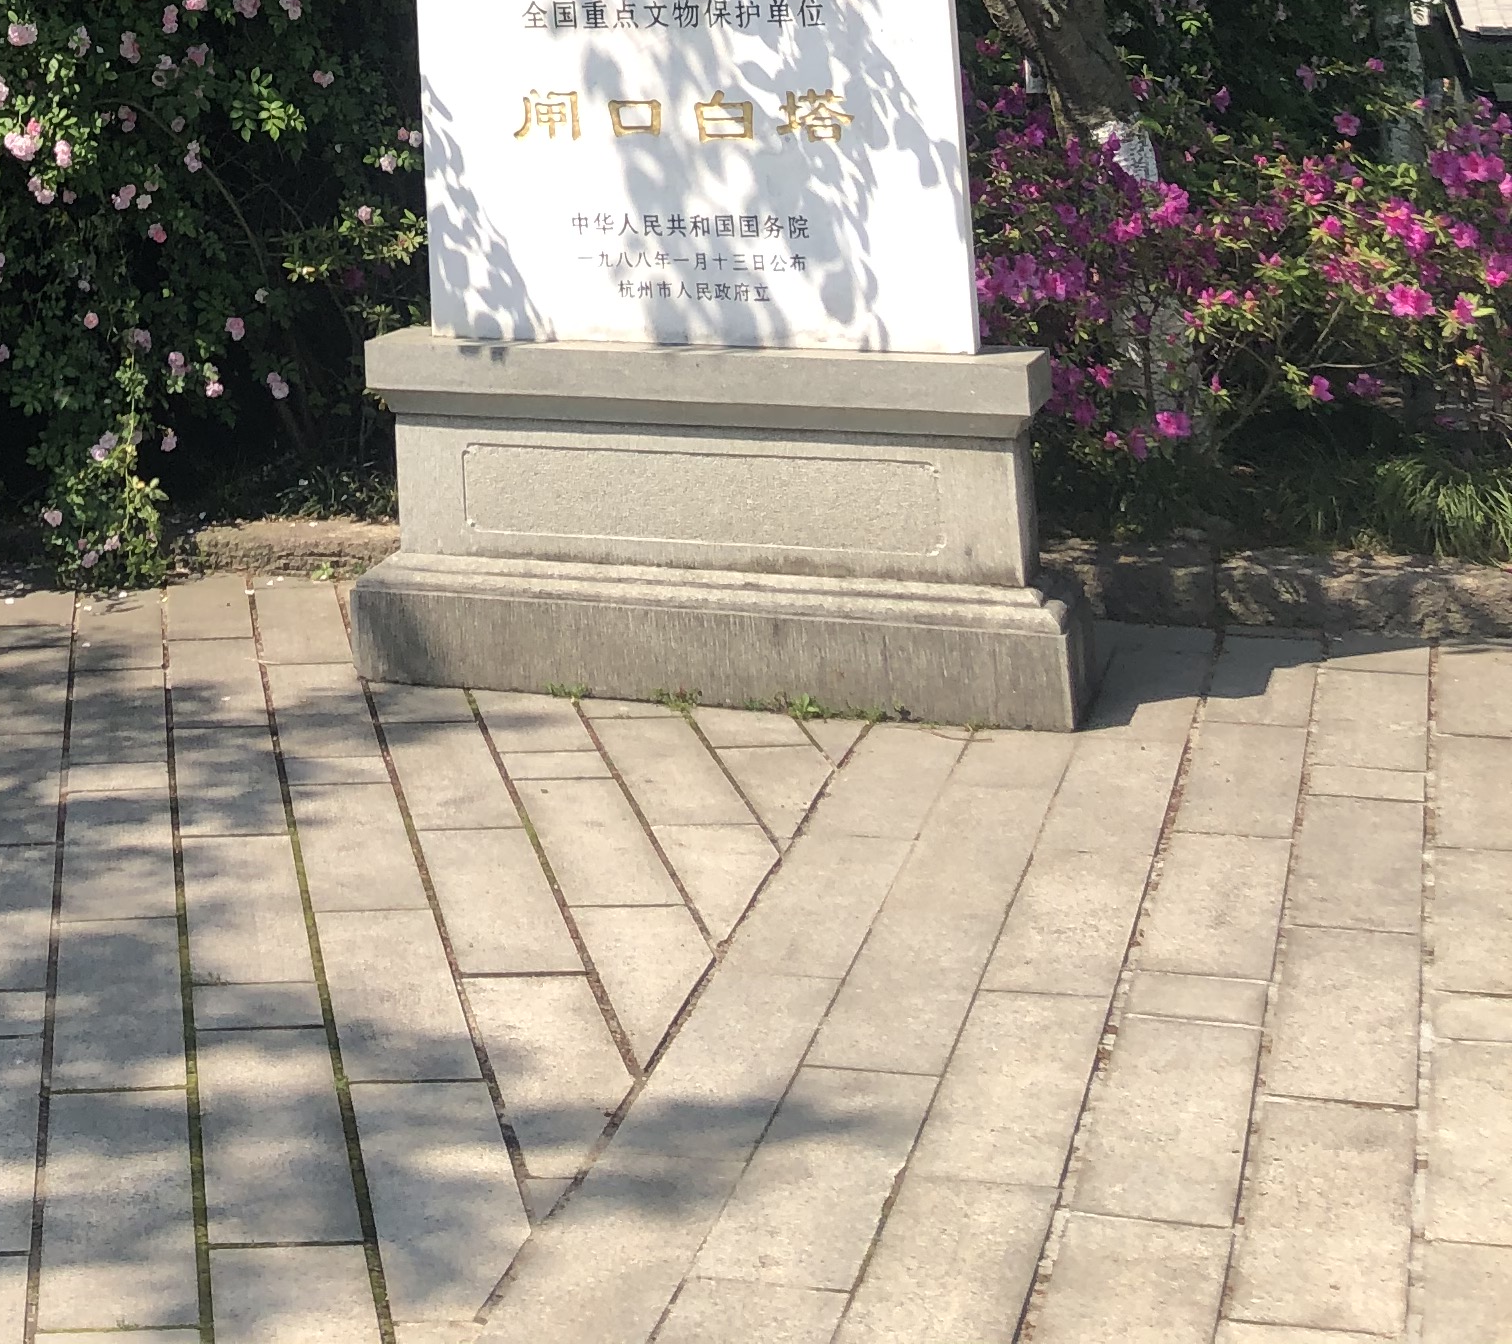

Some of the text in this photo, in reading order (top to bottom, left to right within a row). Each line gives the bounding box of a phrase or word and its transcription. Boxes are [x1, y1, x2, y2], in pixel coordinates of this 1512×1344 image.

[513, 88, 855, 143] 闸口白塔
[571, 212, 810, 240] 中华人民共和国国务院
[577, 250, 807, 273] 一九八八年一月十三日公布
[618, 279, 771, 303] 杭州市人民政府立
